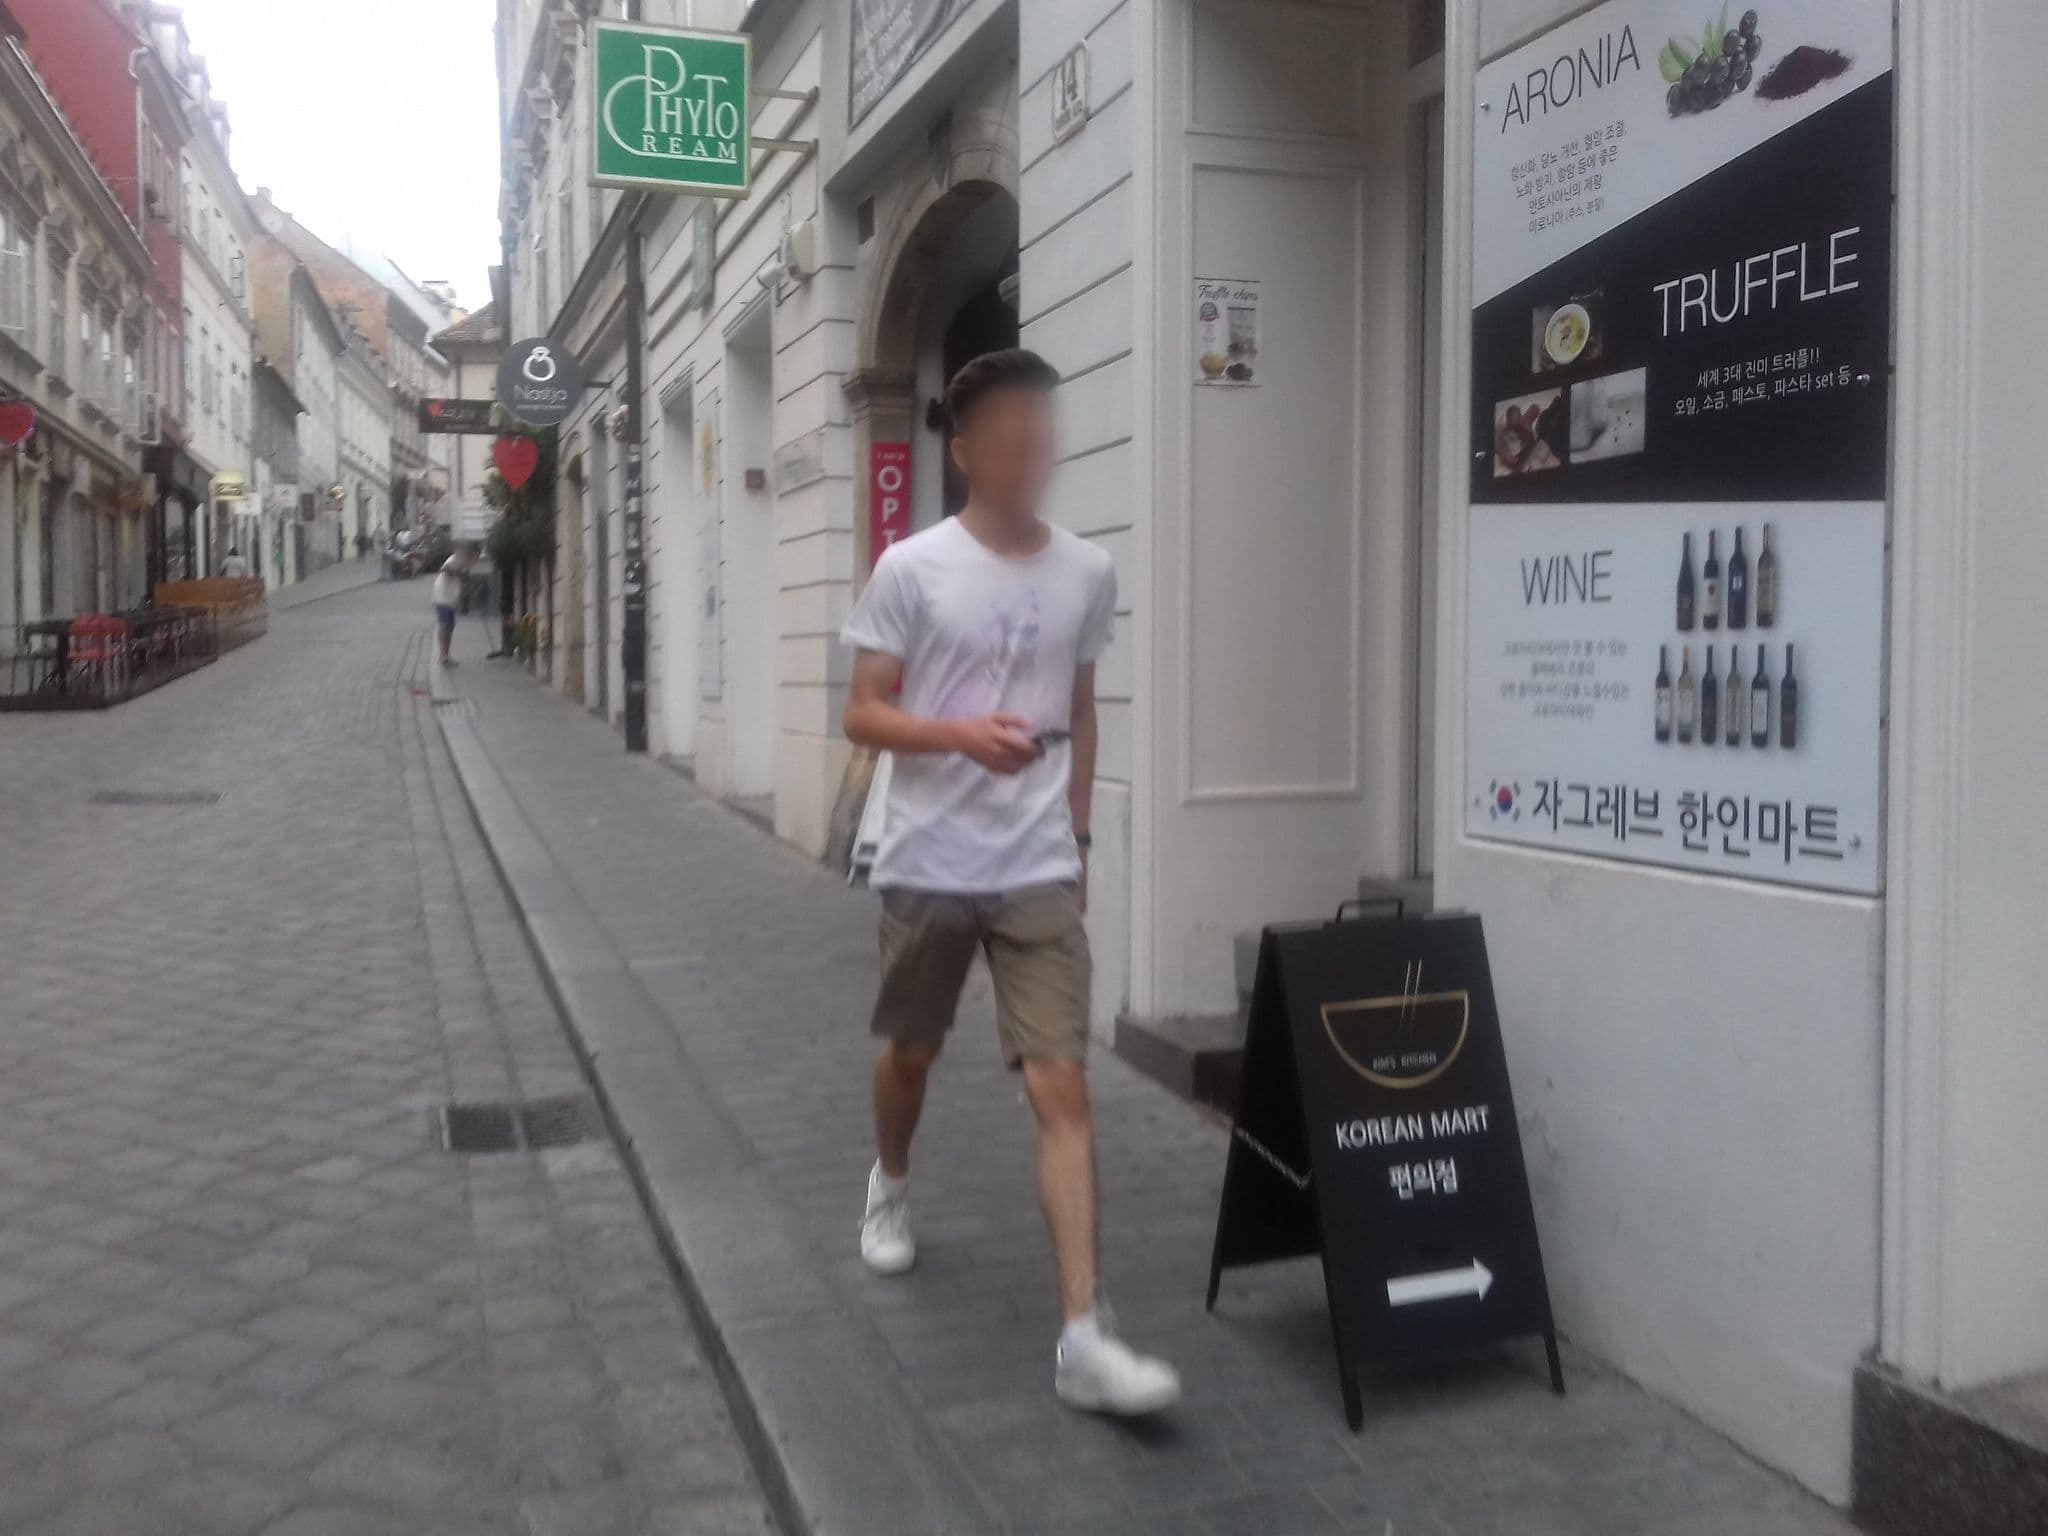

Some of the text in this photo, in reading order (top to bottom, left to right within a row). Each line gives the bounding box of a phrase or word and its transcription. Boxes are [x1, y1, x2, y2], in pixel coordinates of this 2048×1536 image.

[641, 45, 739, 139] PHYTO
[1501, 24, 1640, 134] ARONIA
[1516, 181, 1533, 198] 노화
[1559, 163, 1576, 183] 항암
[1579, 153, 1597, 174] 등에
[1653, 226, 1860, 337] TRUFFLE
[1675, 396, 1699, 415] 오일,
[1732, 382, 1769, 405] 페스토,
[1775, 373, 1811, 397] 파스타
[1815, 371, 1833, 389] set
[1838, 365, 1851, 386] 등
[1697, 347, 1820, 389] 세계 3대 진미 트러플!!
[1522, 549, 1613, 605] WINE
[1532, 777, 1844, 864] 자그레브 한인마트
[1335, 1104, 1489, 1150] KOREAN MART
[1388, 1156, 1458, 1200] 편의점
